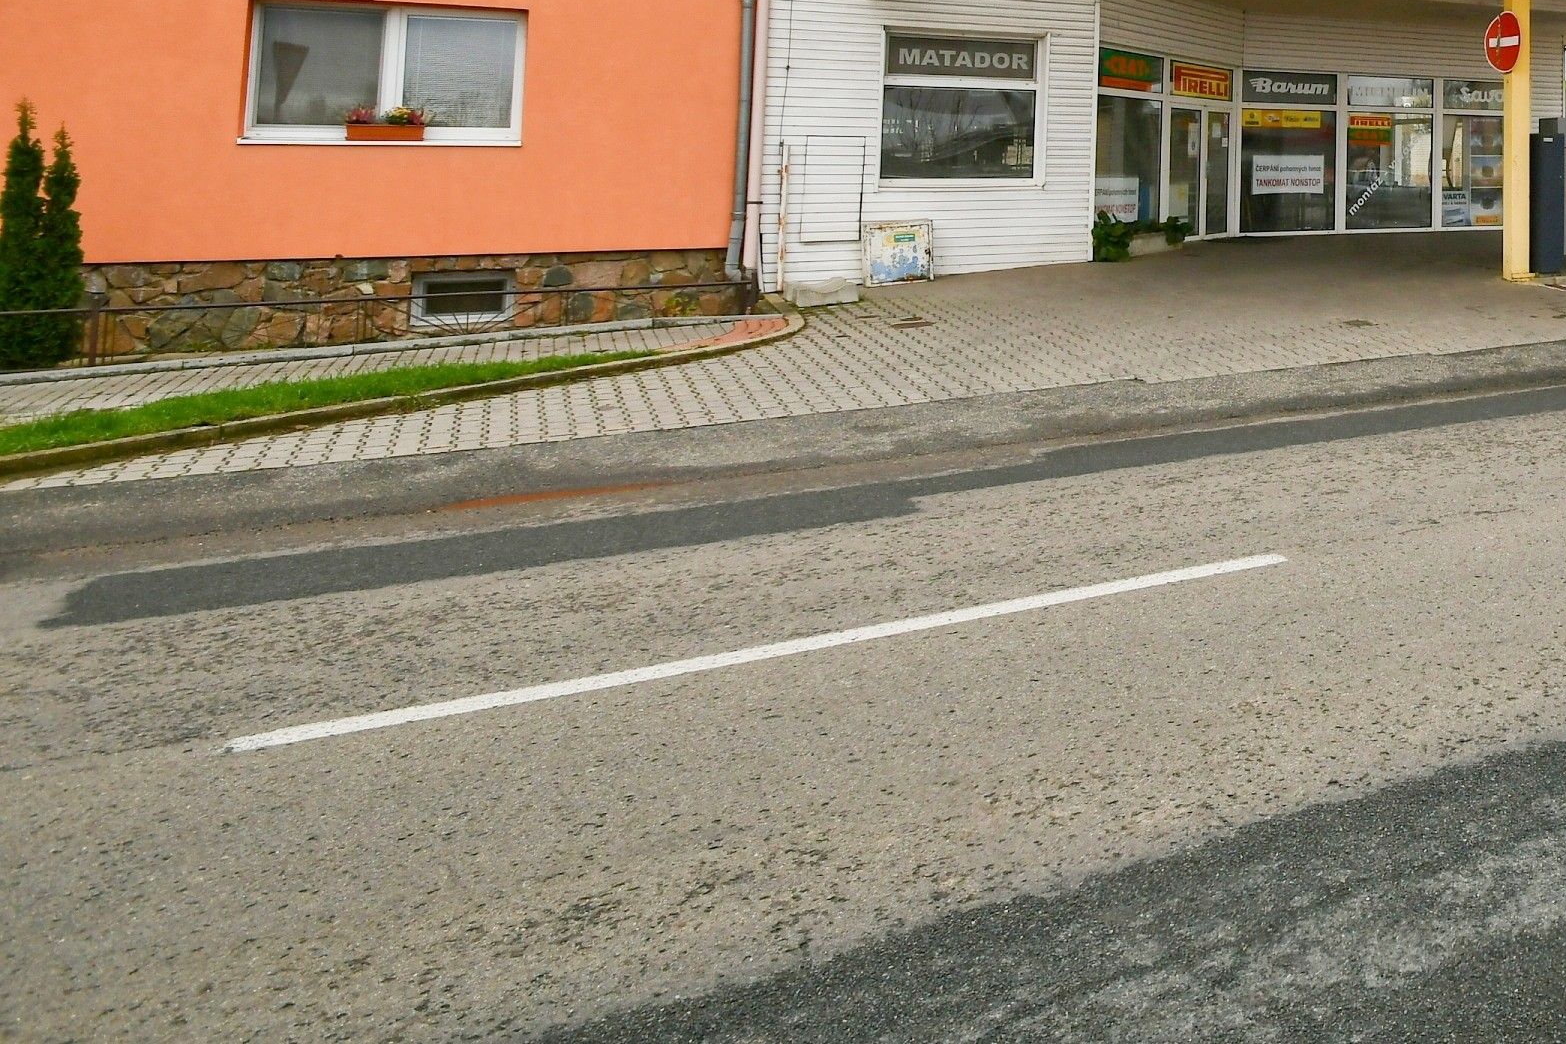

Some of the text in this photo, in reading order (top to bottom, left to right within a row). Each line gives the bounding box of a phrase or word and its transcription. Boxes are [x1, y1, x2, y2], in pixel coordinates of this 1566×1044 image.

[899, 48, 1029, 70] MATADOR
[1174, 65, 1229, 97] PIRELLI
[1249, 77, 1330, 95] Barum
[1350, 116, 1392, 127] PIRELLI
[1256, 178, 1321, 187] TANKOMAT NONSTOP
[1443, 192, 1467, 201] VARTA
